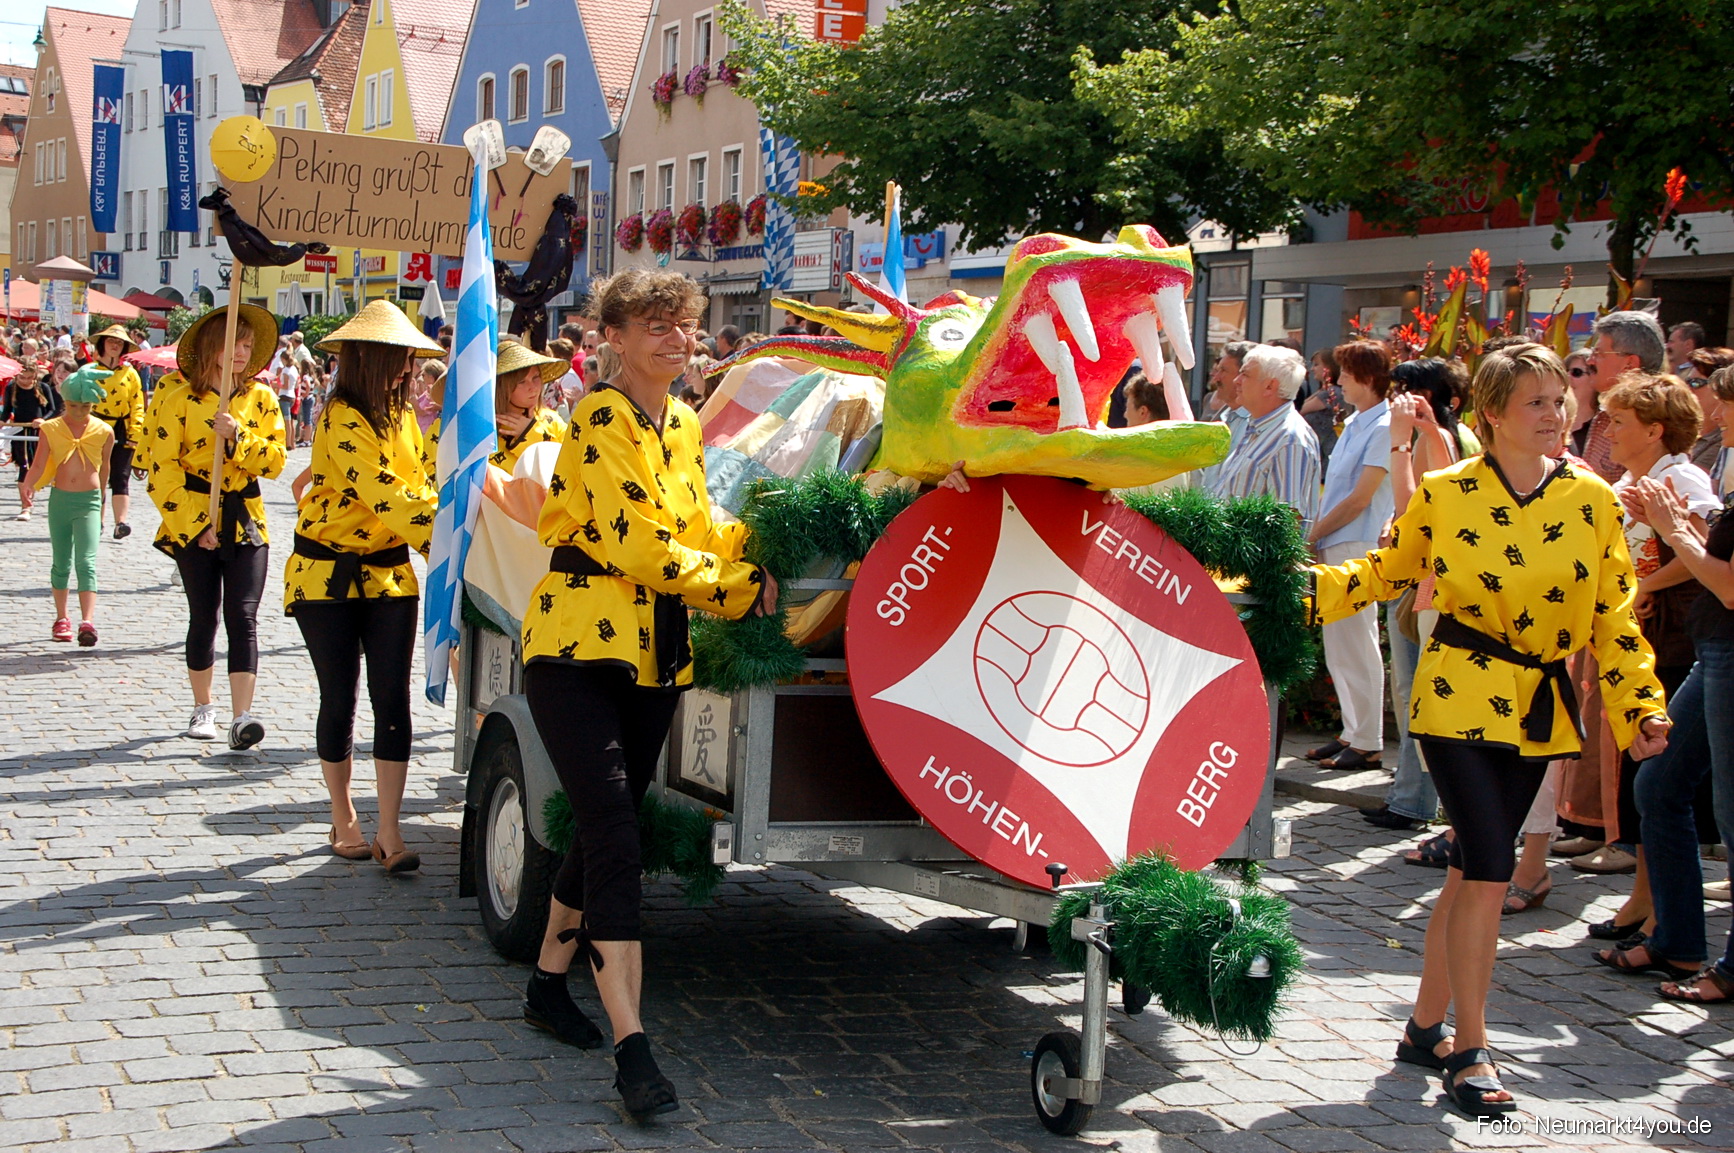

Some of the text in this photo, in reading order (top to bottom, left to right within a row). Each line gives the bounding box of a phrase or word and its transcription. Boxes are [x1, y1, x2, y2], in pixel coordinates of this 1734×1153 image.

[177, 119, 191, 211] K&L RUPPERT
[277, 136, 362, 194] Peking
[372, 150, 444, 198] grüßt
[280, 269, 311, 284] Restaurant
[833, 231, 842, 288] KINO
[876, 525, 953, 627] SPORT-
[1080, 509, 1192, 606] VEREIN
[918, 755, 1050, 859] HÖHEN-
[1176, 740, 1239, 828] BERG
